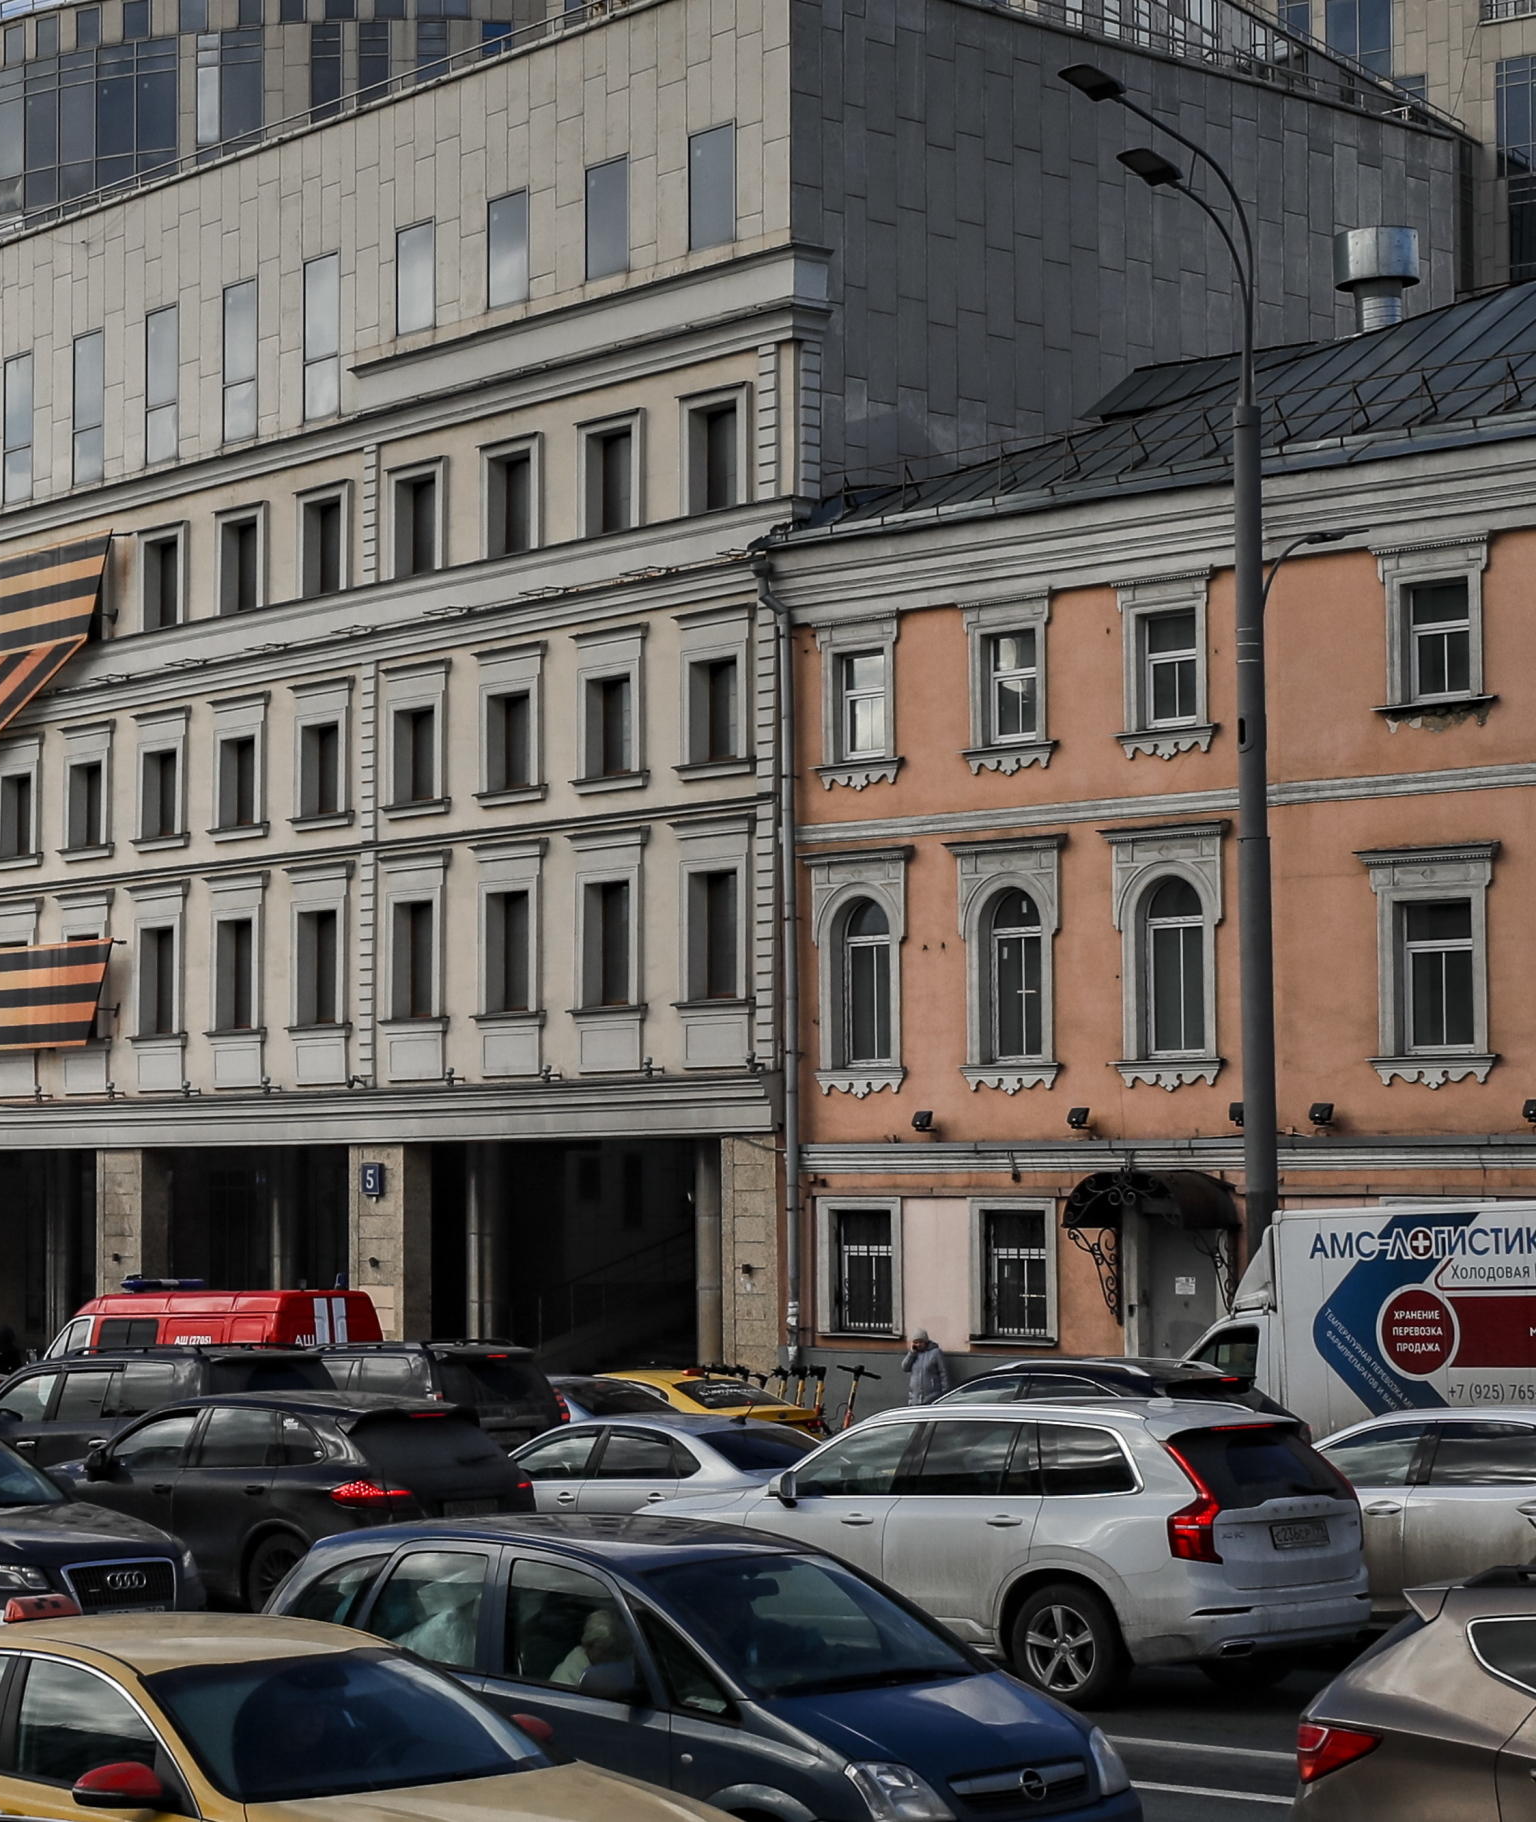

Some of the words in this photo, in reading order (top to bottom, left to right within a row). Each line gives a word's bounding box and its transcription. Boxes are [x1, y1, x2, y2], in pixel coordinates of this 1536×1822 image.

[366, 1169, 375, 1189] 5
[1394, 1310, 1440, 1320] ХРАНЕНИЕ
[1392, 1326, 1443, 1336] ПЕРЕВОЗКА
[174, 1335, 187, 1345] АШ
[1396, 1342, 1441, 1354] ПРОДАЖА
[1324, 1308, 1372, 1363] ТЕМПЕРАТУРНАЯ
[1371, 1361, 1403, 1399] ПЕРЕВОЗКА
[1326, 1330, 1379, 1389] ФАРМПРЕПАРАТОВ
[1448, 1384, 1464, 1400] +7
[1469, 1383, 1505, 1403] (925)
